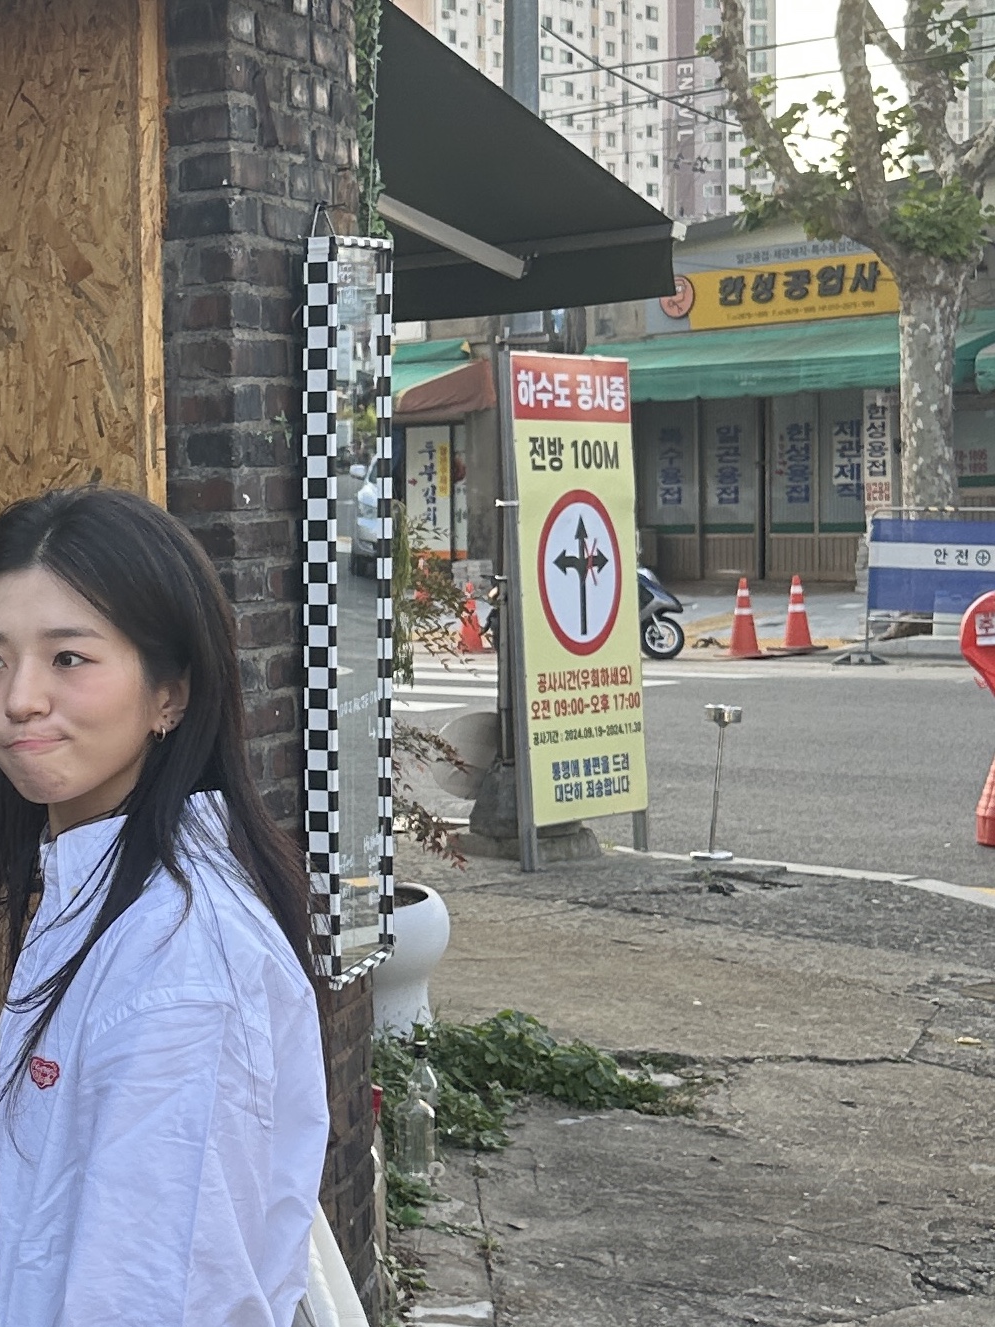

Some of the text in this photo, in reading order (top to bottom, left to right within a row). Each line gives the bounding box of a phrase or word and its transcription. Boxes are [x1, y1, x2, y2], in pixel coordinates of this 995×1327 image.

[718, 260, 881, 307] 한성공업사
[516, 369, 626, 412] 하수도 공사중
[529, 436, 620, 471] 전방 100M
[531, 699, 551, 720] 오전
[612, 692, 641, 711] 17:00
[554, 775, 630, 804] 대단히 죄송합니다
